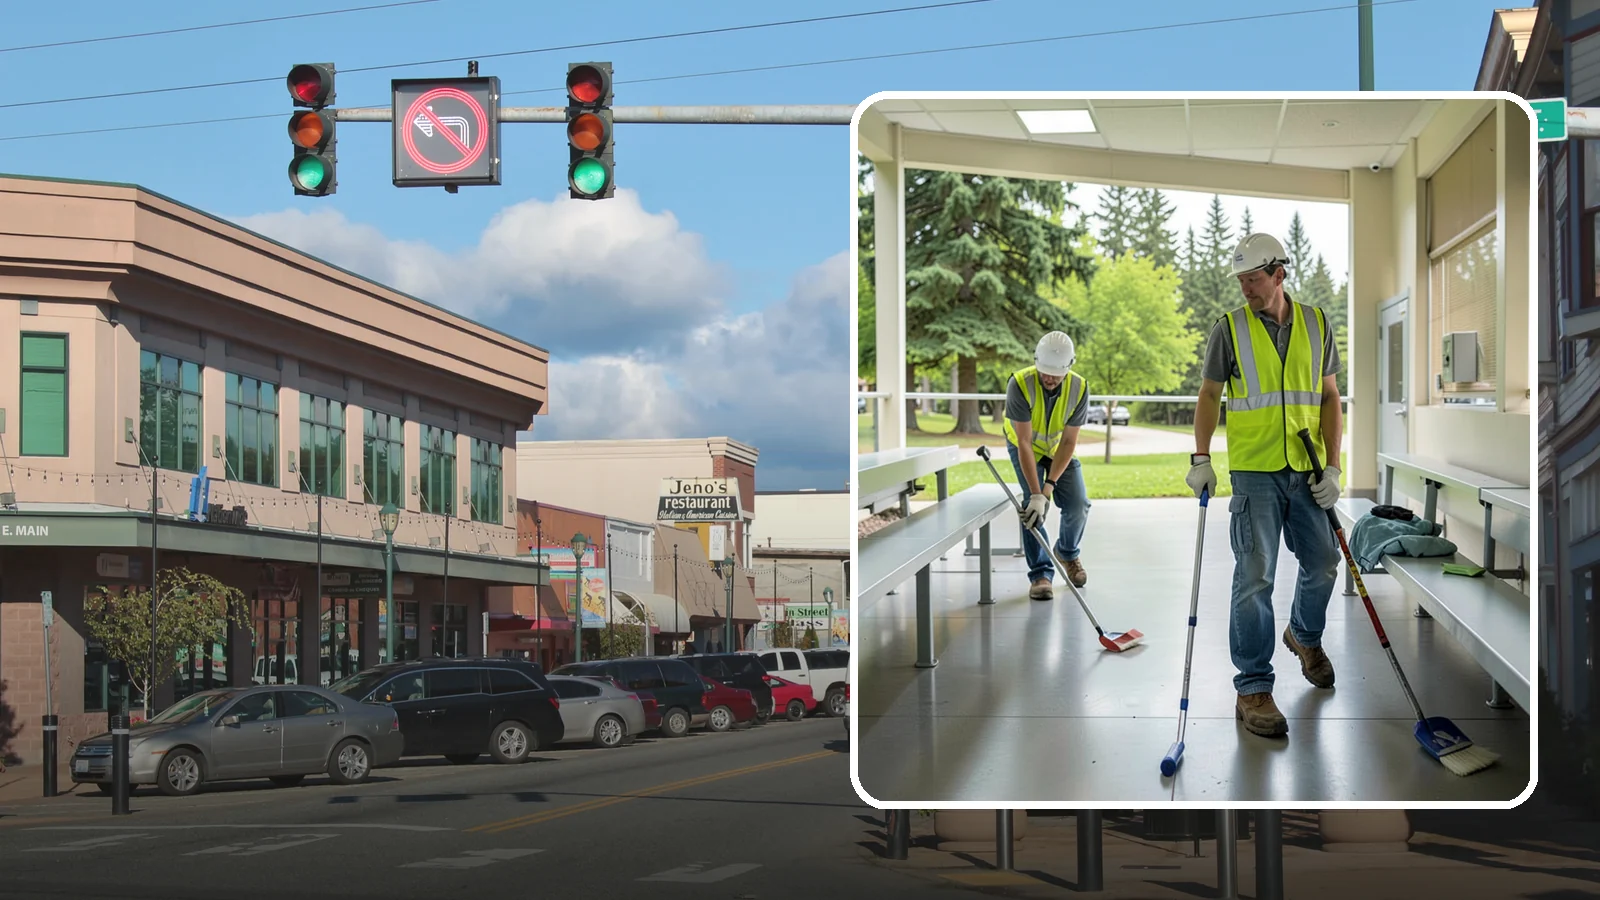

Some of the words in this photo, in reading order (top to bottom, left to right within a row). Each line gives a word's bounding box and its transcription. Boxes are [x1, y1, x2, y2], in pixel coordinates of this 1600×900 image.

[670, 480, 727, 495] Jeno's
[665, 496, 731, 509] restaurant
[658, 510, 682, 520] Italian
[686, 510, 714, 519] American
[714, 509, 737, 519] Cuisine
[2, 525, 13, 536] E.
[15, 525, 49, 536] MAIN
[797, 607, 829, 616] Street
